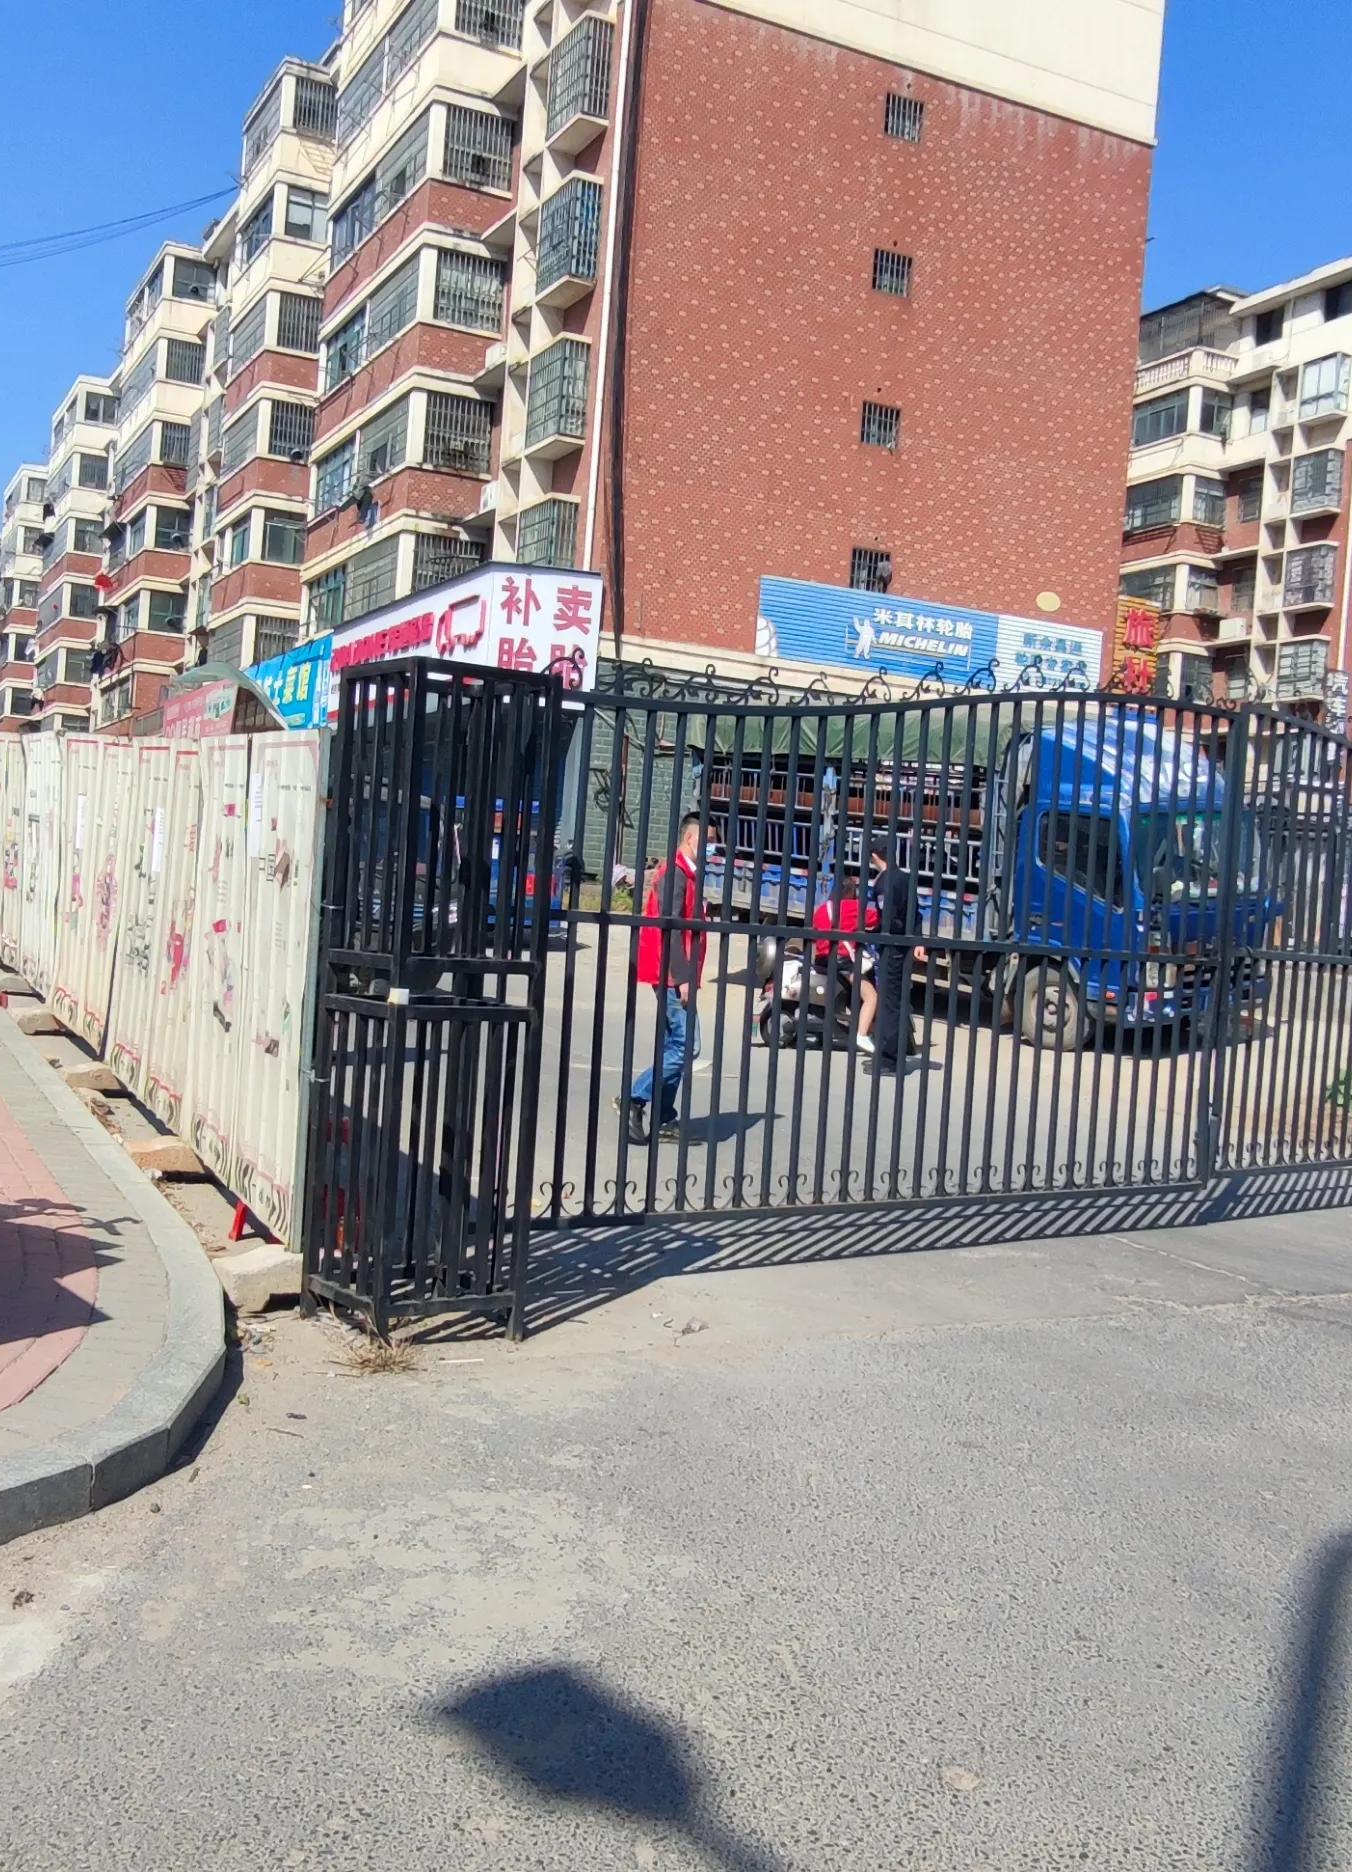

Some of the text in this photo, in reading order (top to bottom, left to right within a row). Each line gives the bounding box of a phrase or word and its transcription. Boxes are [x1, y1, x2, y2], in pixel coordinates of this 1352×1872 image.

[500, 576, 541, 673] 补胎
[873, 607, 973, 640] 米其林轮胎
[878, 631, 969, 657] MICHELIN
